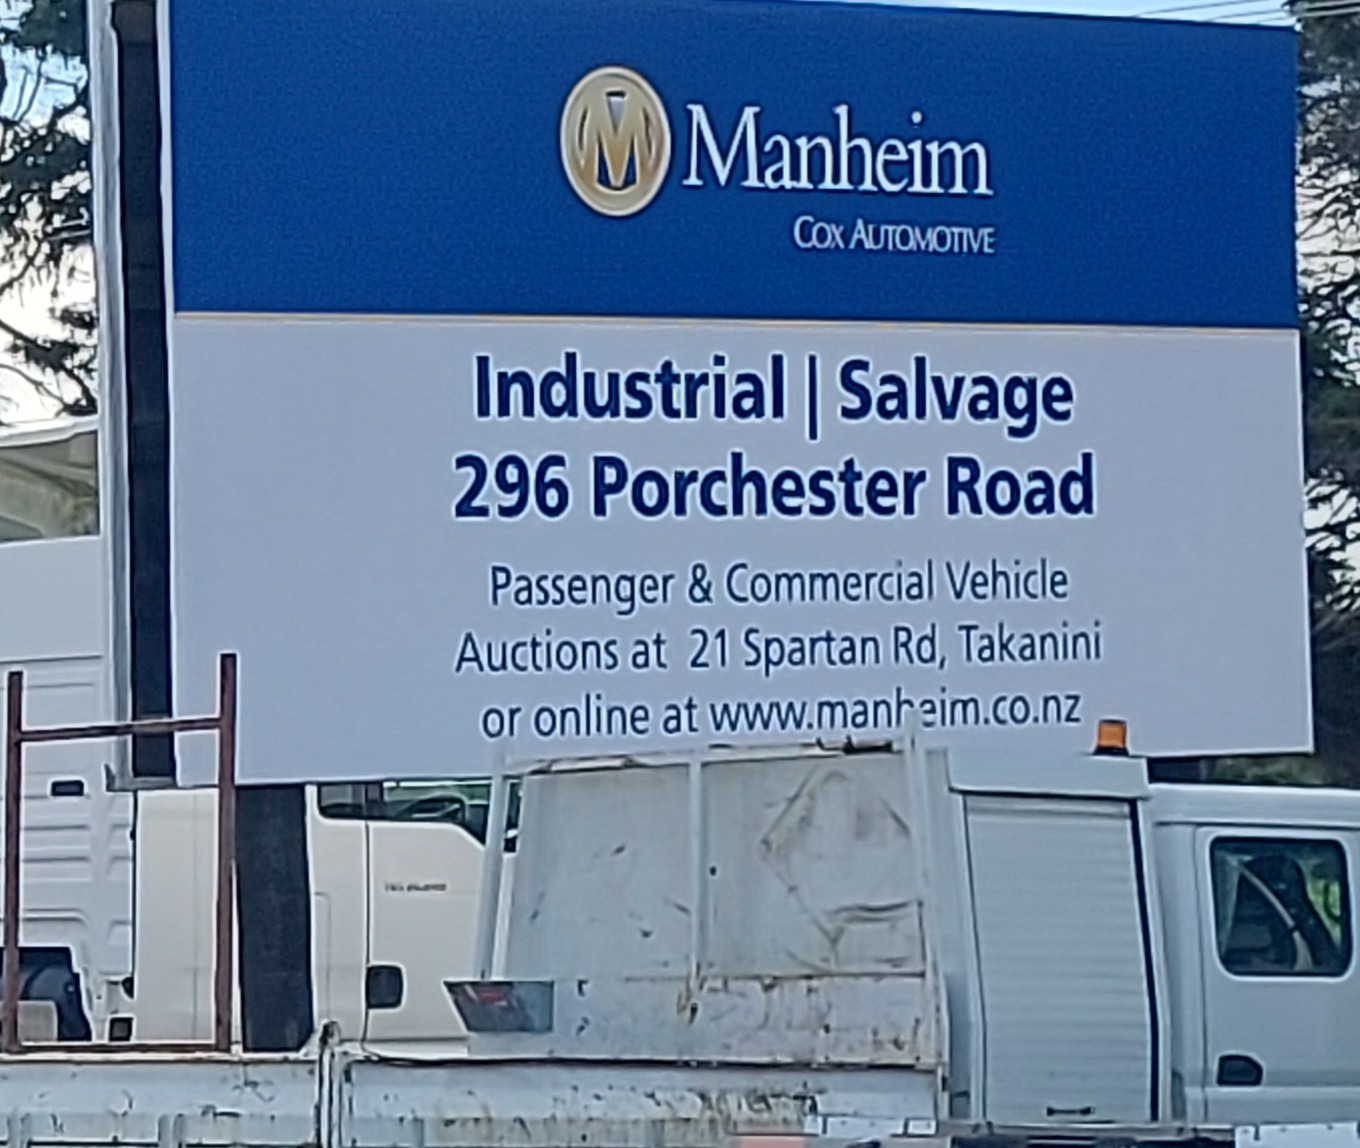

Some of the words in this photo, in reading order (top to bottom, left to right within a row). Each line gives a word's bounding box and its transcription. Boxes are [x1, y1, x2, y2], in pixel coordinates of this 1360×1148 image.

[682, 103, 994, 196] Manheim
[476, 351, 785, 420] Industrial
[839, 356, 1075, 439] Salvage
[454, 453, 570, 519] 296
[592, 451, 928, 518] Porchester
[946, 452, 1095, 517] Road
[491, 565, 676, 616] Passenger
[688, 563, 714, 604] &
[725, 559, 934, 603] Commercial
[945, 557, 1069, 600] Vehicle
[455, 628, 620, 673] Auctions
[631, 632, 668, 670] at
[689, 628, 727, 668] 21
[744, 627, 880, 675] Spartan
[893, 623, 947, 670] Rd,
[957, 619, 1102, 663] Takanini
[482, 707, 523, 739] or
[534, 692, 650, 737] online
[662, 696, 700, 734] at
